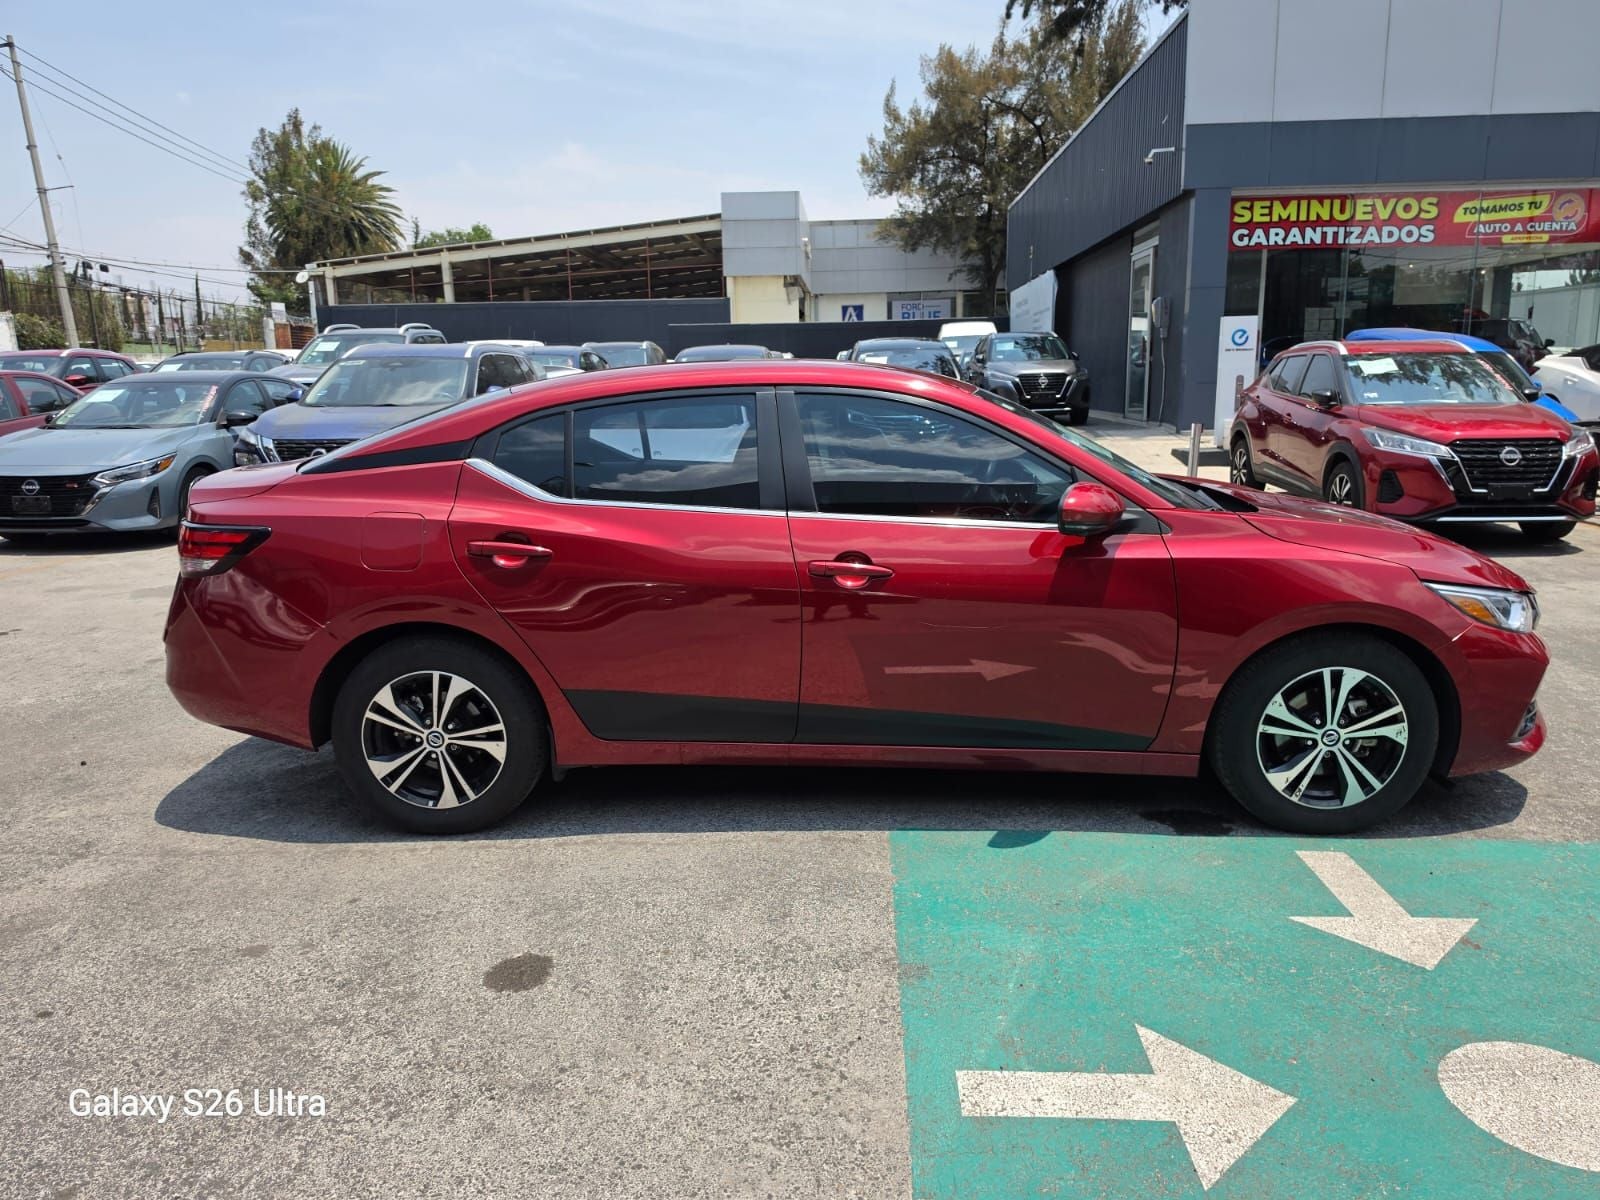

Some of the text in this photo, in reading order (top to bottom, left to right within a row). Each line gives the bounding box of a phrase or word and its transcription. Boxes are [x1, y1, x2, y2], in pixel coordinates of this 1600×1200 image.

[1232, 197, 1440, 224] SEMINUEVOS
[1463, 200, 1543, 216] TOMAMOS TU
[1231, 224, 1435, 246] GARANTIZADOS
[1473, 221, 1577, 233] AUTO A CUENTA
